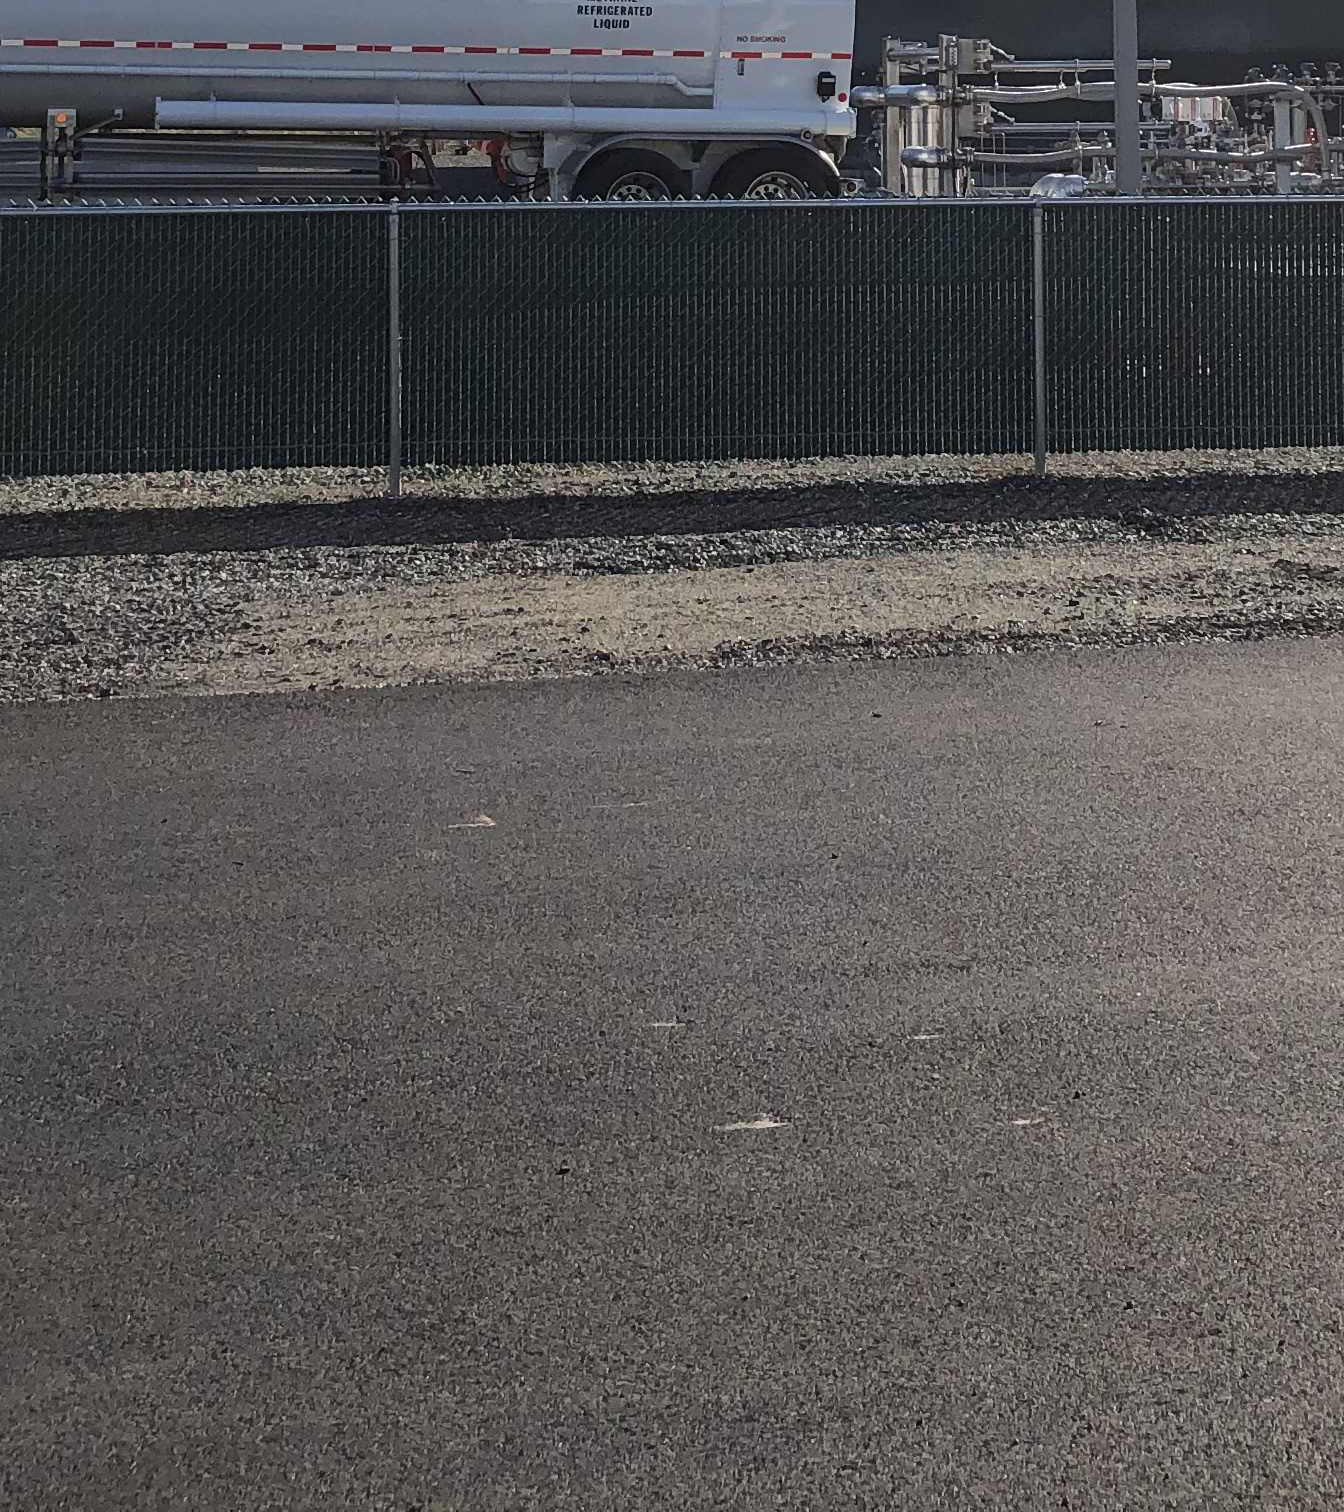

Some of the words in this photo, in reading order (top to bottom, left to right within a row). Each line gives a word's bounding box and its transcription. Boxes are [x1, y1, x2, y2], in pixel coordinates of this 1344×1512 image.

[576, 4, 653, 17] REFRIGERATED
[593, 18, 630, 29] LIQUID
[736, 35, 749, 43] NO
